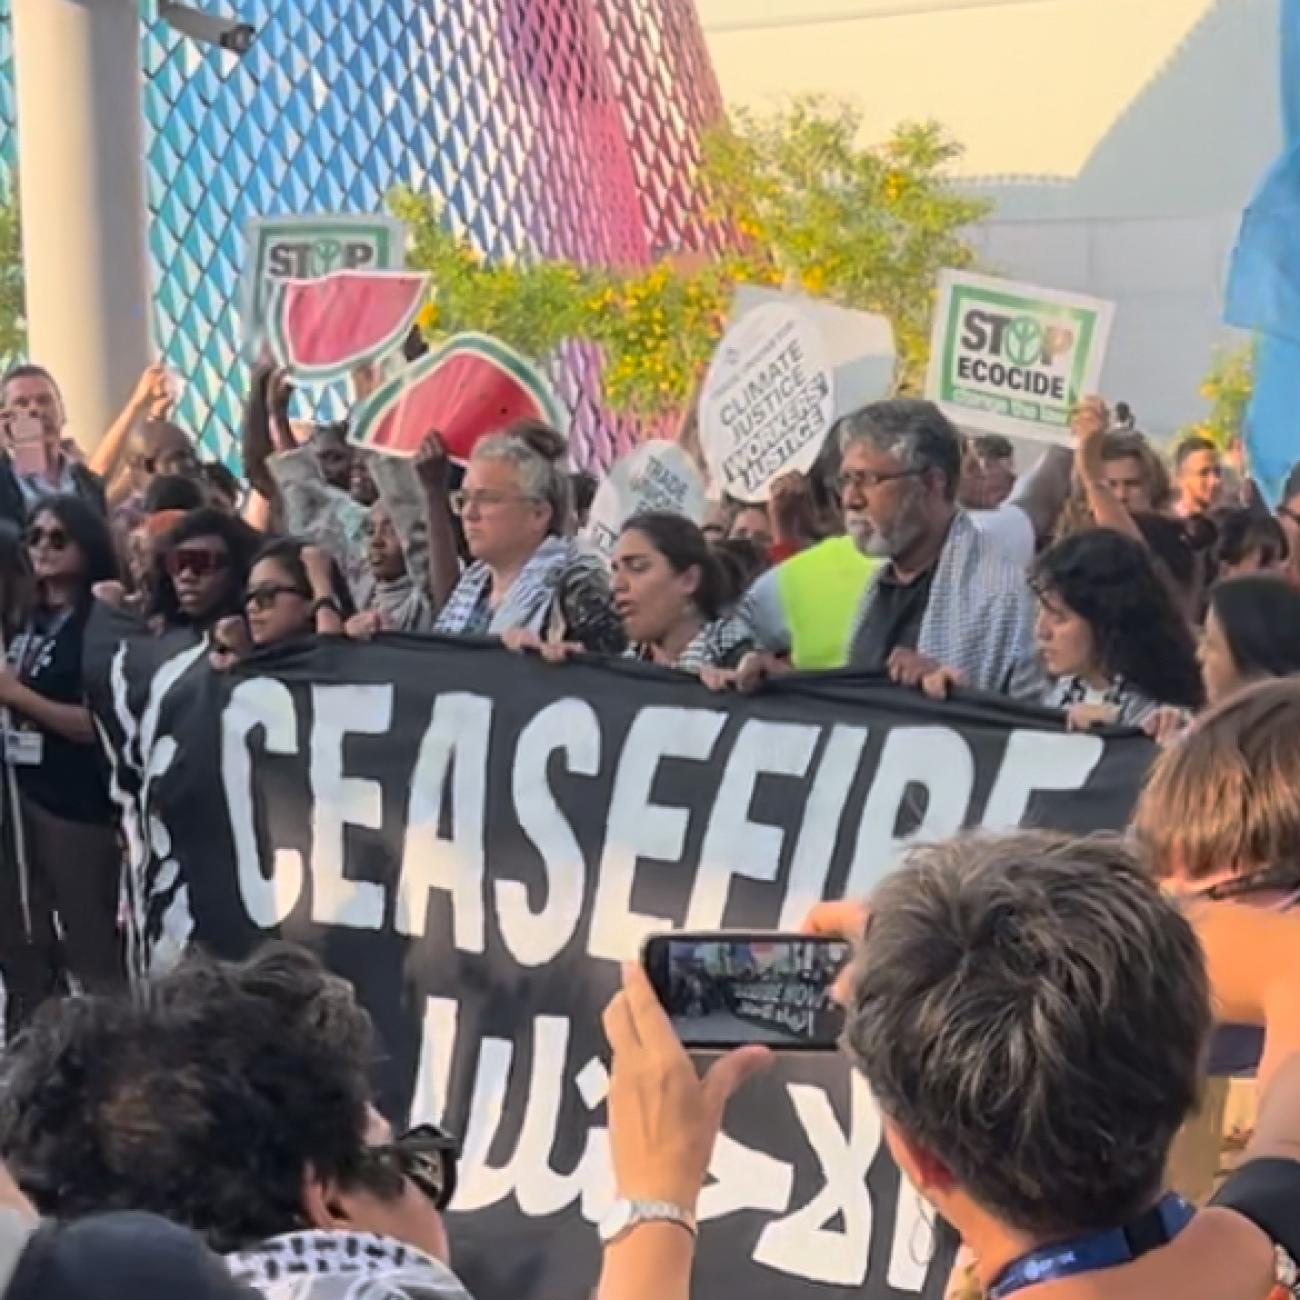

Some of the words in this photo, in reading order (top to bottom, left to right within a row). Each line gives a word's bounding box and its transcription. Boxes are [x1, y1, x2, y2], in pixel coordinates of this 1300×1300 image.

[962, 310, 1073, 366] STOP
[719, 338, 804, 425] CLIMATE
[727, 367, 806, 442] JUSTICE
[958, 357, 1065, 400] ECOCIDE
